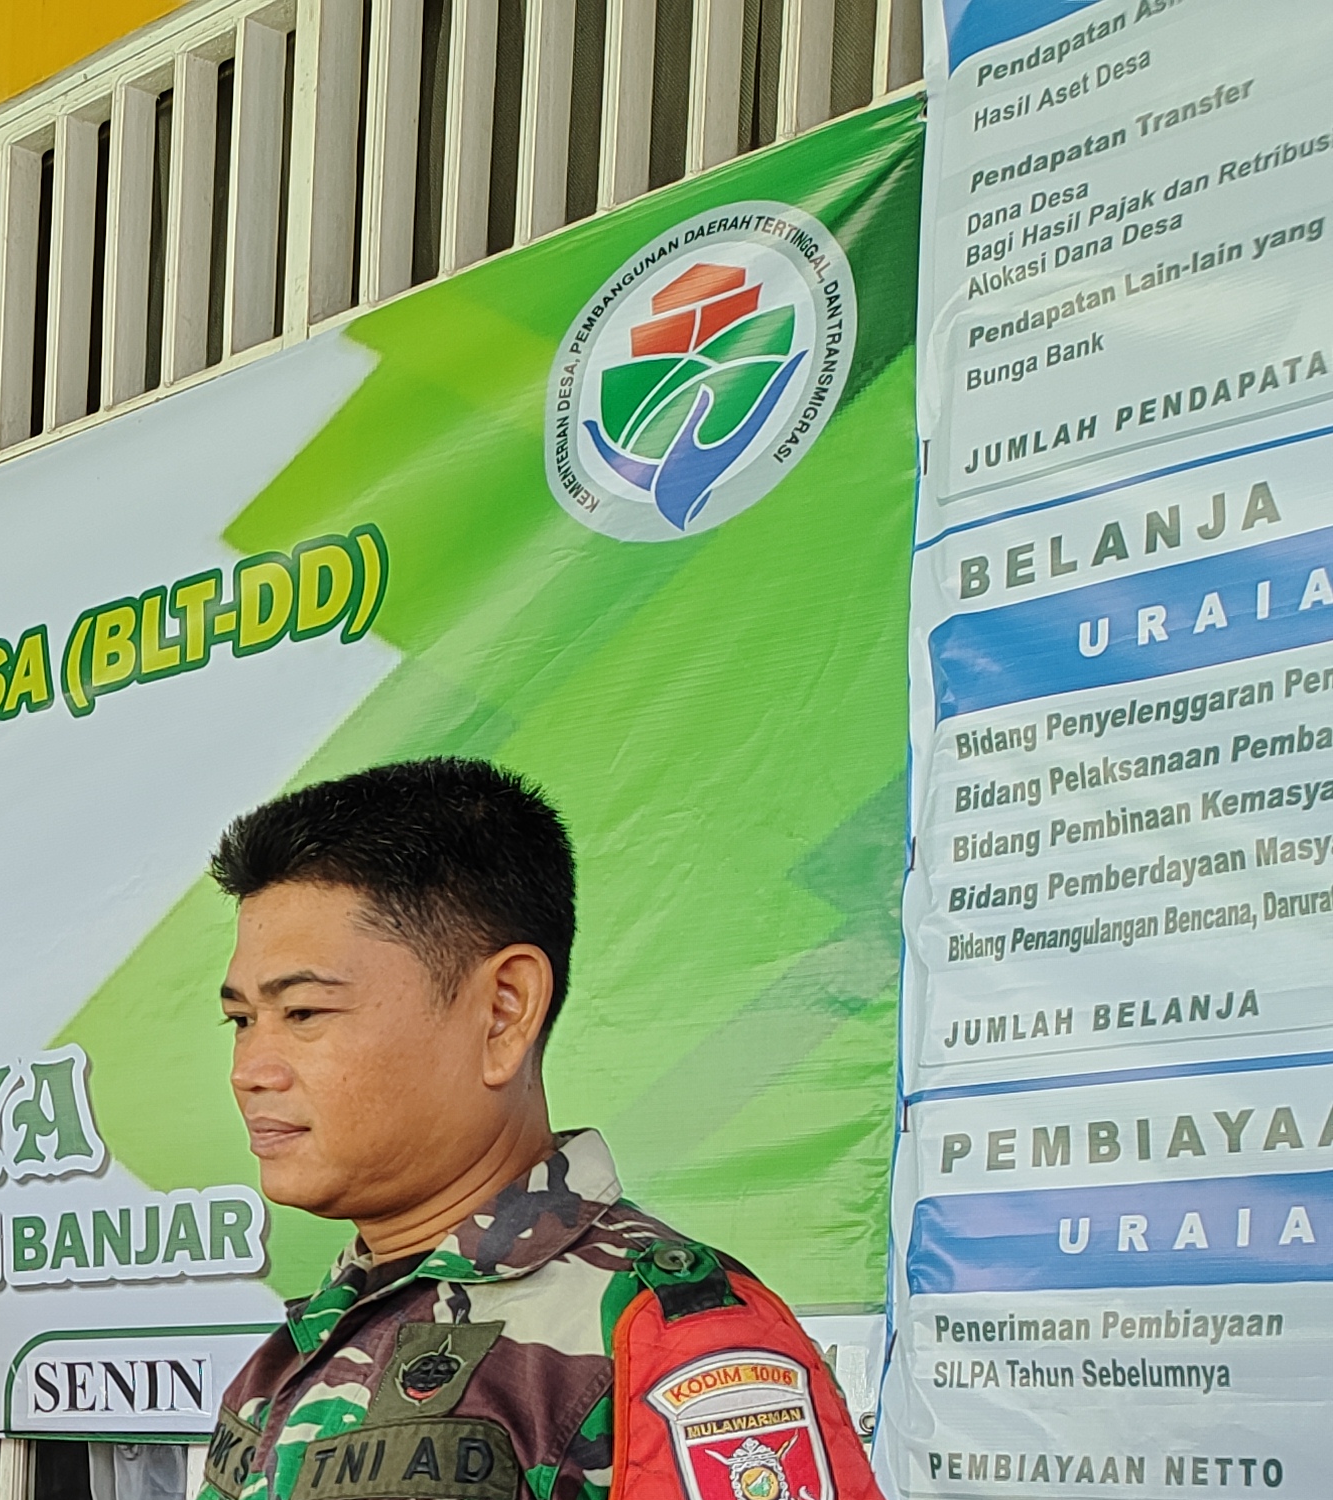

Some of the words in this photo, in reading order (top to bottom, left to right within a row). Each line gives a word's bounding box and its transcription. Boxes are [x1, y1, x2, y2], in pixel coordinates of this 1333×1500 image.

[977, 14, 1127, 88] Pendapatan
[974, 95, 1032, 132] Hasil
[1036, 74, 1090, 113] Aset
[1096, 48, 1152, 88] Desa
[970, 128, 1127, 193] Pendapatan
[1135, 78, 1254, 138] Transfer
[683, 214, 754, 245] DAERAH
[966, 237, 1014, 268] Bagi
[1022, 212, 1080, 247] Hasil
[1088, 188, 1155, 229] Pajak
[1163, 174, 1209, 203] dan
[1217, 128, 1333, 186] Retribus
[967, 205, 1022, 236] Dana
[1031, 182, 1090, 214] Desa
[968, 252, 1048, 300] Alokasi
[1055, 236, 1114, 268] Dana
[1122, 212, 1184, 246] Desa
[968, 286, 1117, 348] Pendapatan
[1124, 243, 1243, 297] Lain-lain
[1252, 216, 1327, 261] yang
[570, 236, 679, 356] PEMBANGUNAN
[967, 353, 1039, 391] Bunga
[1045, 331, 1105, 367] Bank
[556, 411, 600, 513] KEMENTERIAN
[964, 414, 1098, 474] JUMLAH
[959, 480, 1282, 601] BELANJA
[62, 524, 388, 717] (BLT-DD)
[956, 723, 1037, 761] Bidang
[1046, 678, 1274, 742] Penyelenggaran
[955, 775, 1042, 814] Bidang
[1050, 744, 1221, 797] Pelaksanaan
[953, 826, 1041, 864] Bidang
[1050, 800, 1192, 848] Pembinaan
[948, 878, 1039, 913] Bidang
[1047, 845, 1247, 901] Pemberdayaan
[1255, 833, 1333, 868] Masy
[947, 933, 1006, 963] Bidang
[1010, 917, 1159, 956] Penangulangan
[1164, 900, 1258, 936] Bencana,
[944, 1007, 1074, 1048] JUMLAH
[1092, 989, 1261, 1032] BELANJA
[12, 1198, 255, 1274] BANJAR
[935, 1313, 1091, 1344] Penerimaan
[1102, 1310, 1285, 1346] Pembiayaan
[32, 1357, 207, 1414] SENIN
[670, 1366, 742, 1402] KODIM
[751, 1365, 793, 1386] 1006
[933, 1361, 1000, 1389] SILPA
[1006, 1358, 1075, 1389] Tahun
[1082, 1358, 1231, 1394] Sebelumnya
[686, 1408, 803, 1438] MULAWARMAN
[310, 1437, 386, 1488] TNI
[928, 1451, 1146, 1485] PEMBIAYAAN
[1165, 1456, 1284, 1488] NETTO
